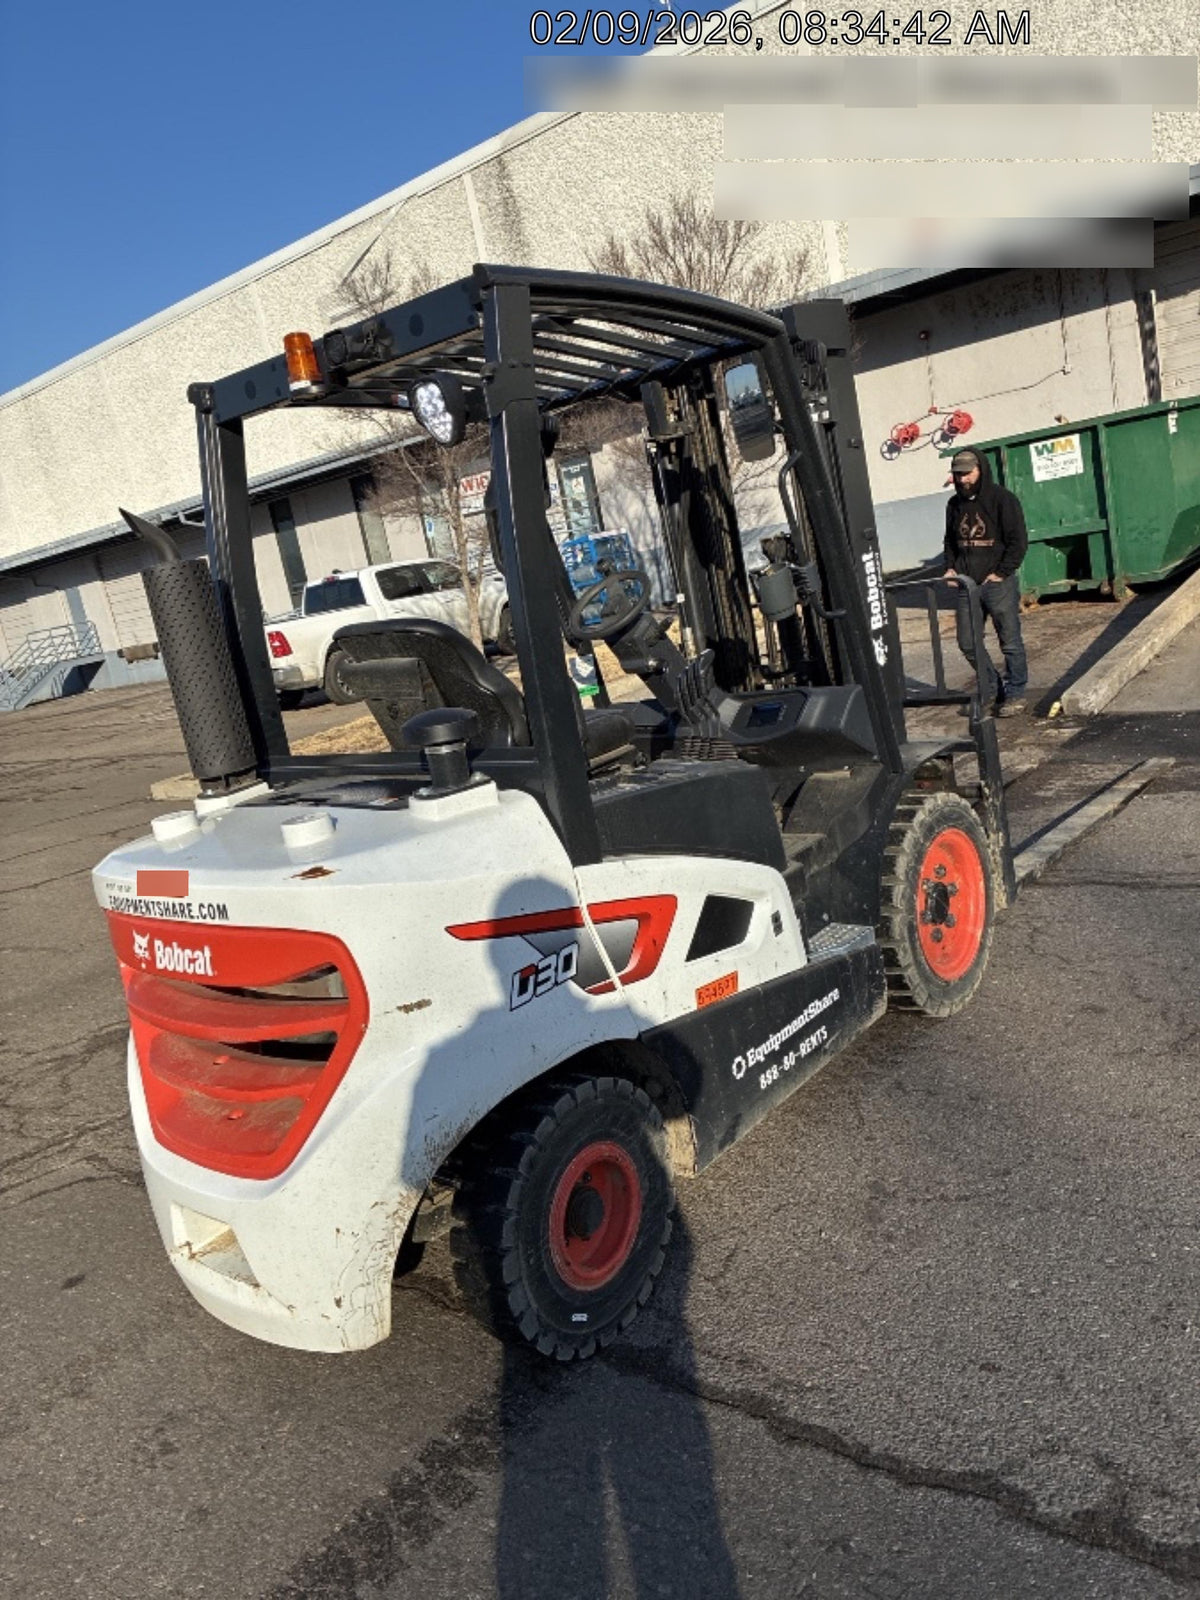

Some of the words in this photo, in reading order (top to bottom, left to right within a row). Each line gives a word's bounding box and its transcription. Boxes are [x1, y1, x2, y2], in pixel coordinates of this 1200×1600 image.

[862, 551, 883, 630] Bobcat
[154, 938, 214, 977] Bobcat
[510, 940, 579, 1012] D30
[746, 988, 840, 1068] EquipmentShare
